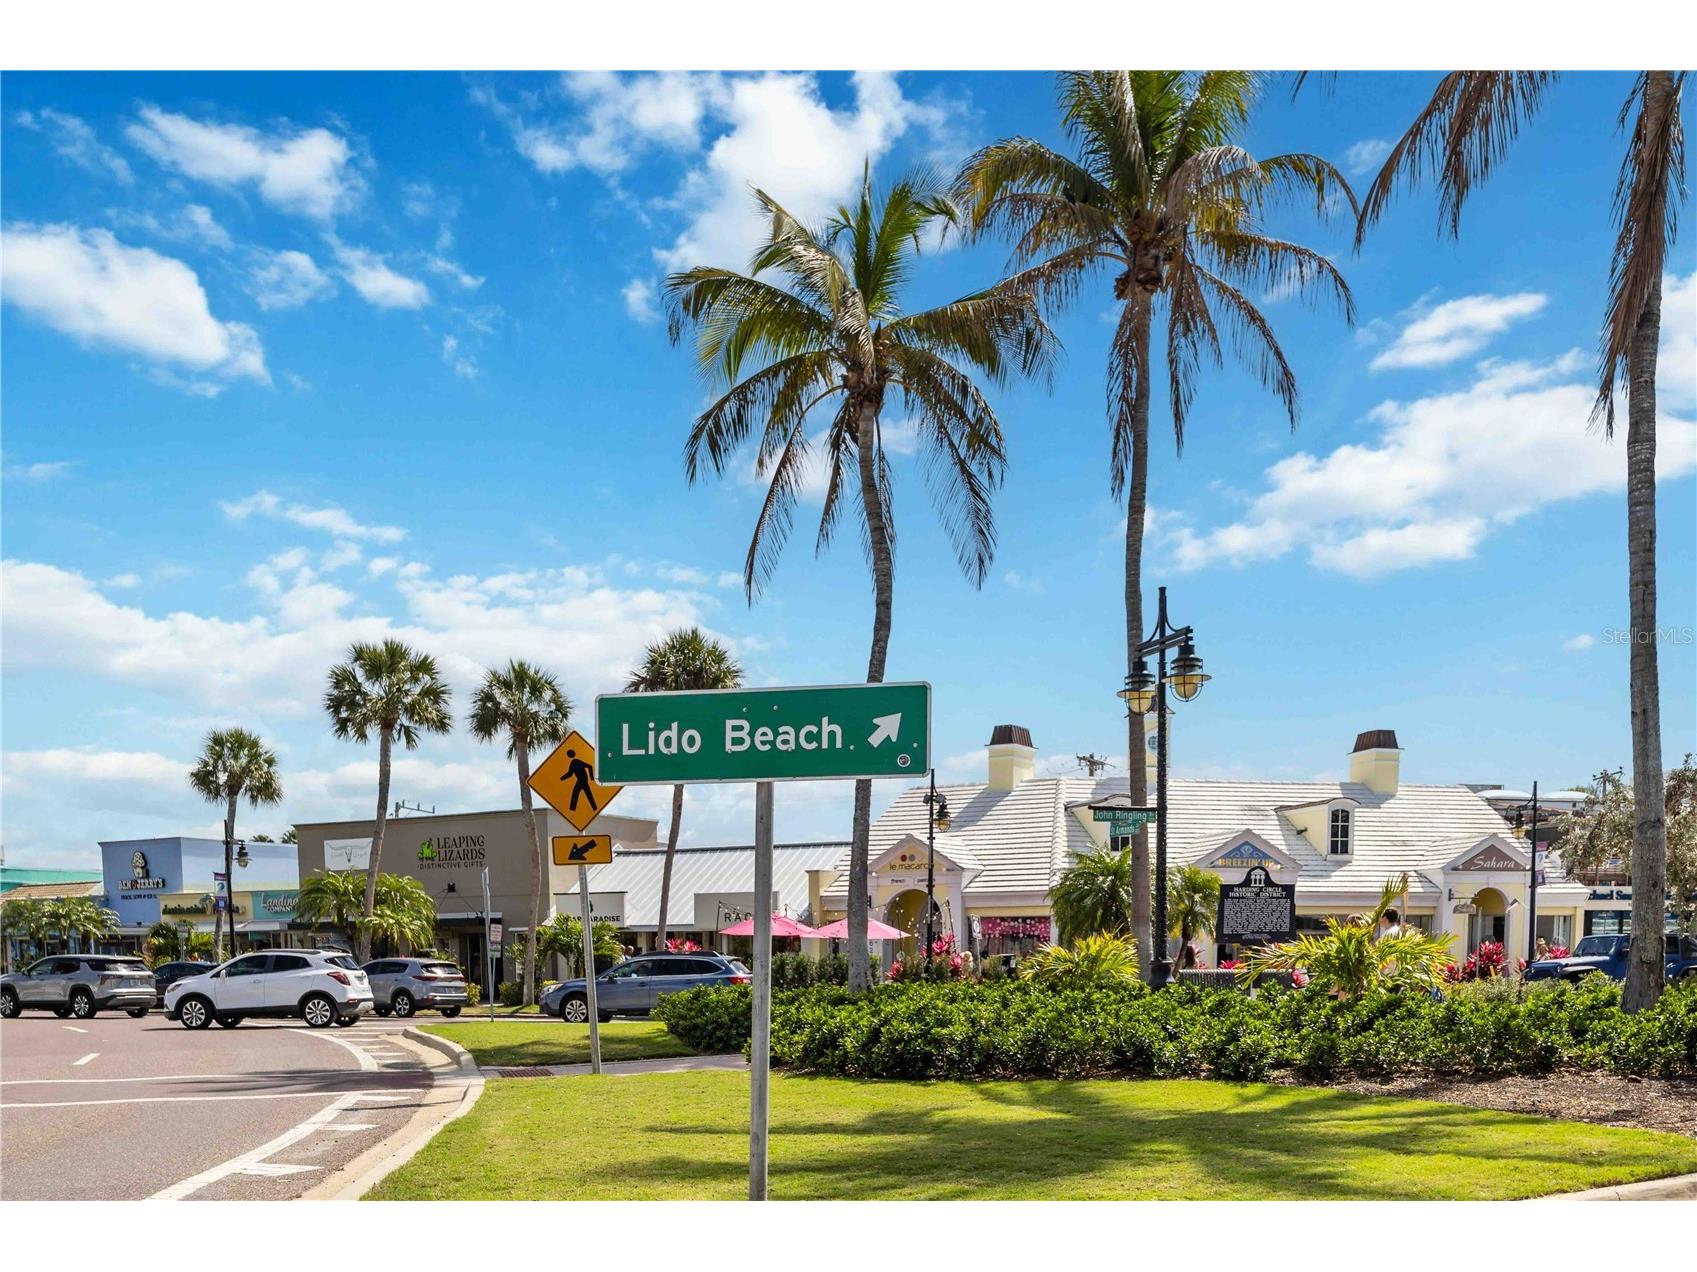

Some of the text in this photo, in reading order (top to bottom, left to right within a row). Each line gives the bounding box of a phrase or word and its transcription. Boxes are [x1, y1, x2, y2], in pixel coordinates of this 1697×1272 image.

[622, 716, 842, 755] Lido Beach
[1094, 811, 1113, 820] John
[1115, 811, 1147, 822] Ringling
[437, 835, 485, 849] LEAPING
[438, 848, 485, 861] LIZARDS
[420, 862, 460, 870] DISTINCTIVE
[889, 862, 935, 871] le macaro
[1471, 856, 1515, 869] Sahara
